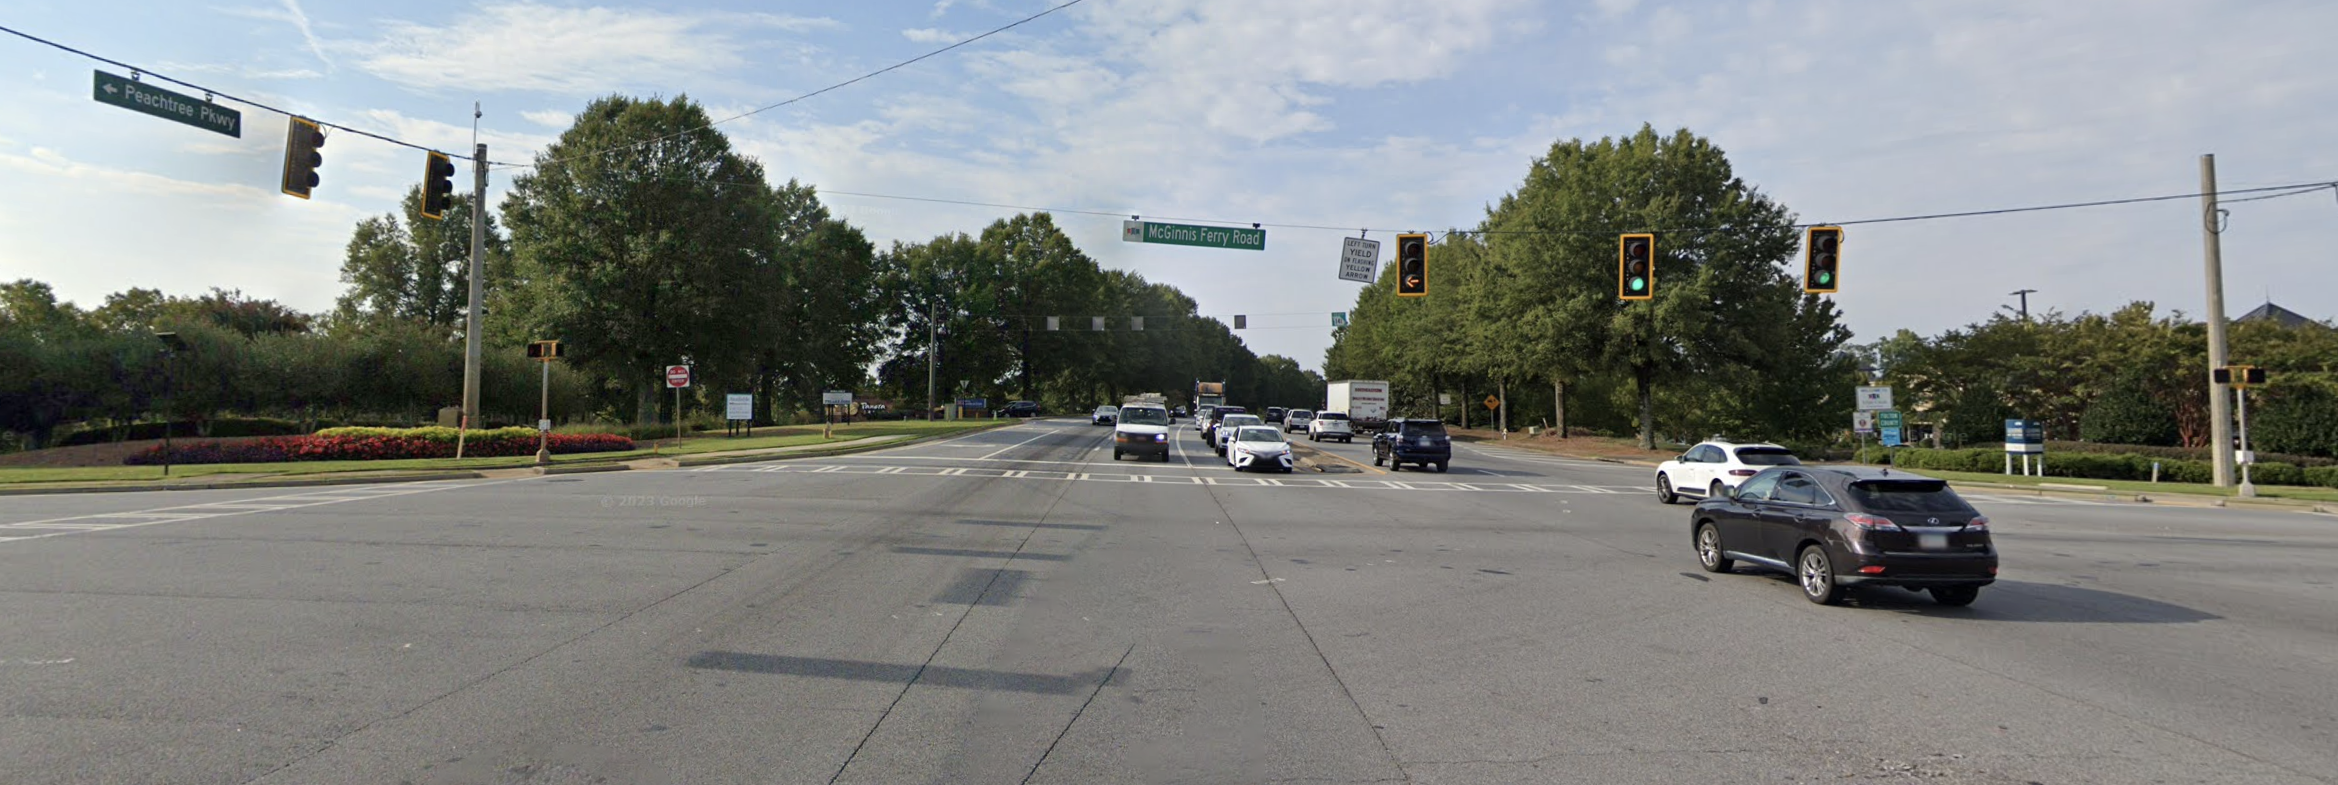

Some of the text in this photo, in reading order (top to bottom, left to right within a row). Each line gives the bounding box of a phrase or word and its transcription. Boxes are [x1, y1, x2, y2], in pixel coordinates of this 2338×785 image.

[124, 84, 236, 131] Peachtree Pkwy
[1148, 223, 1197, 242] McGinnis
[1200, 227, 1229, 246] Ferry
[1232, 229, 1260, 246] Road
[1347, 240, 1376, 250] LEFT TURN
[1350, 248, 1372, 258] YIELD
[1352, 258, 1374, 267] FLASHING
[1345, 264, 1370, 273] YELLOW
[1345, 271, 1368, 280] ARROW
